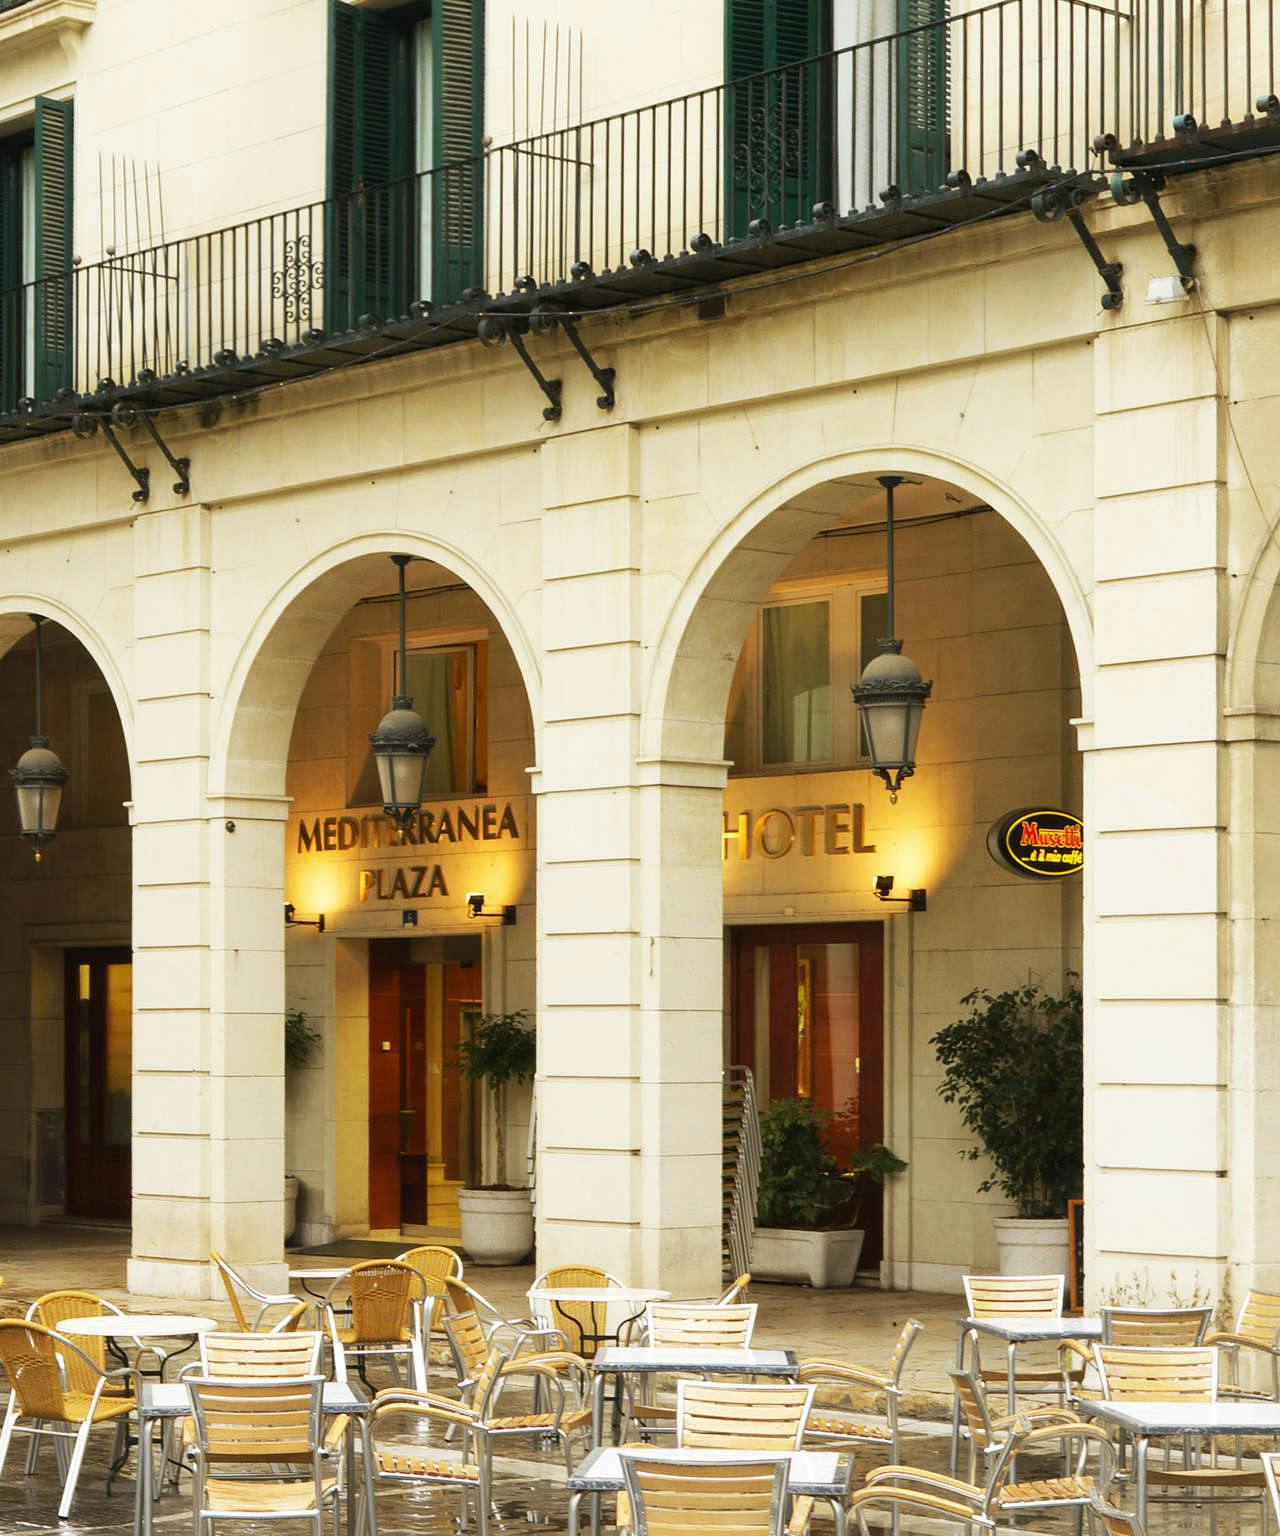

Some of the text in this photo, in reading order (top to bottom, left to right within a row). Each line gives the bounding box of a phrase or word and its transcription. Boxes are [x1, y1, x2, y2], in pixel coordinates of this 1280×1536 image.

[297, 803, 520, 853] MEDITERRANEA
[722, 803, 877, 860] HOTEL
[1020, 821, 1083, 848] Musetti
[1045, 849, 1061, 862] mio
[359, 864, 449, 902] PLAZA
